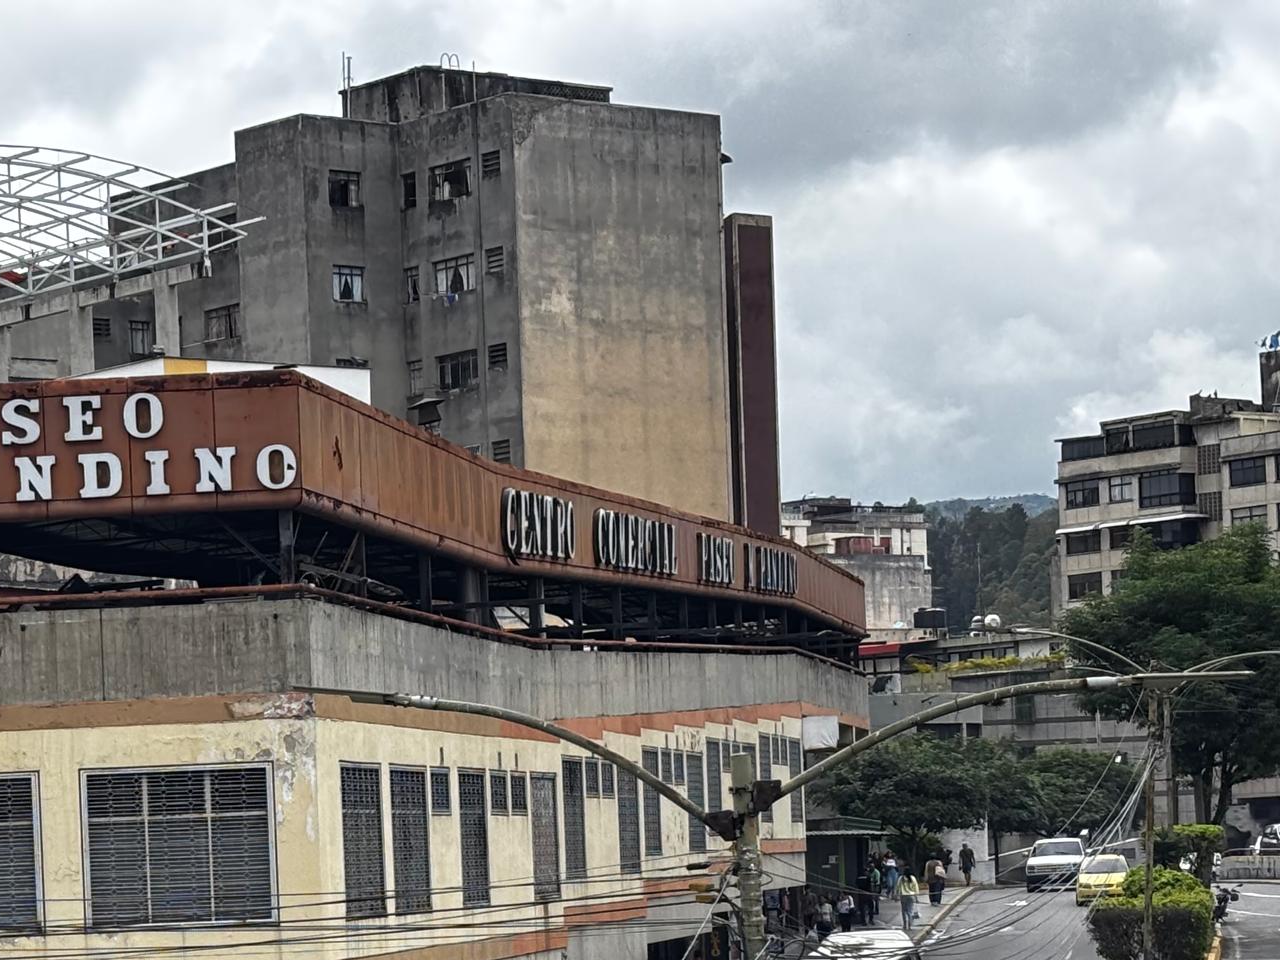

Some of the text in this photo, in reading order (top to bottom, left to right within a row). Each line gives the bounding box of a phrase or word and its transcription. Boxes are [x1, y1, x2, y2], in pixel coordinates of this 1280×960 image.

[503, 487, 576, 560] CENTRO
[595, 507, 678, 575] COMERCIAL
[698, 531, 736, 585] PASEO
